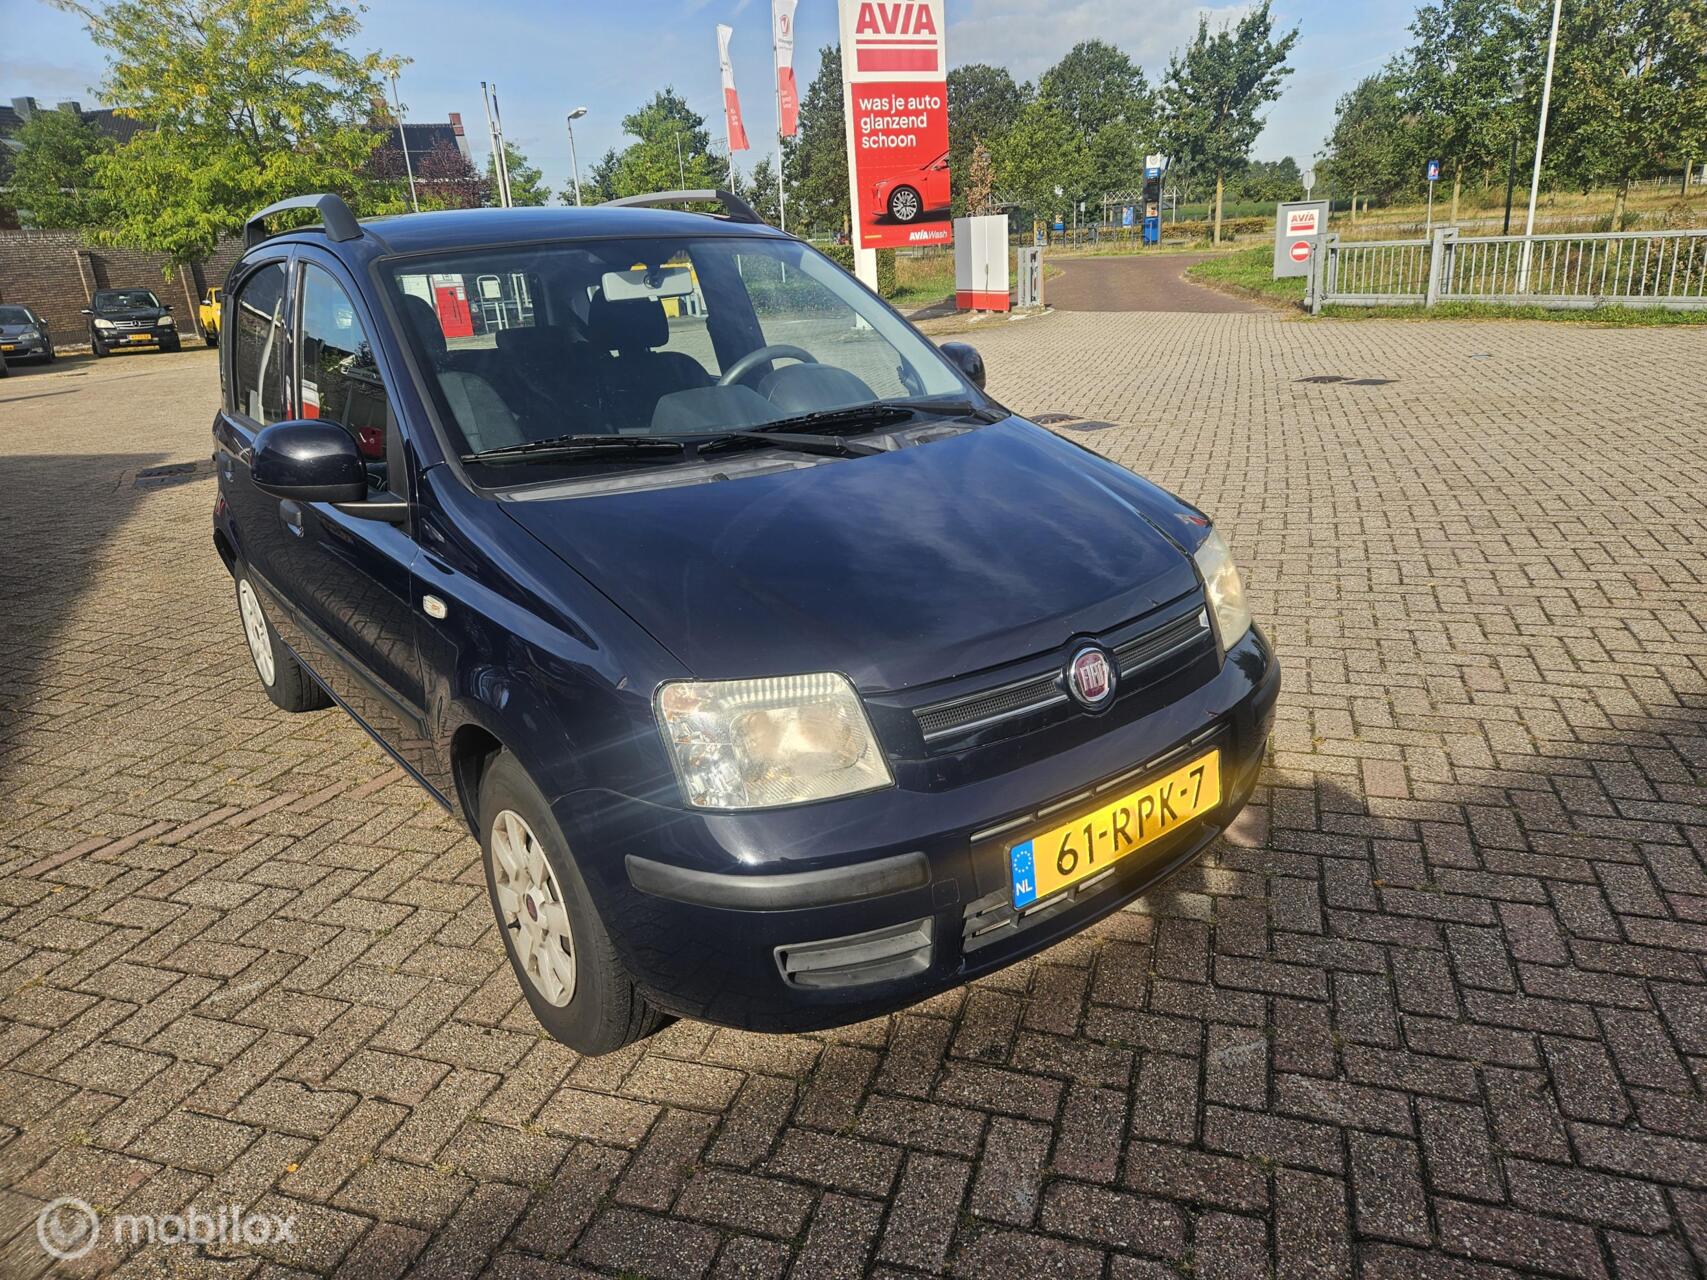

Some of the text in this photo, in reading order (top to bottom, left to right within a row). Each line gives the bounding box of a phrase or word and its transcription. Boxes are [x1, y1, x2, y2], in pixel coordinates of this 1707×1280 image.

[856, 1, 937, 35] AVIA
[859, 94, 941, 114] was je auto
[861, 113, 927, 134] glanzend
[862, 133, 916, 149] schoon
[1291, 213, 1315, 222] AVIA
[1080, 660, 1107, 691] FIAT
[1056, 764, 1205, 876] 61-RPK-7
[1015, 878, 1033, 896] NL
